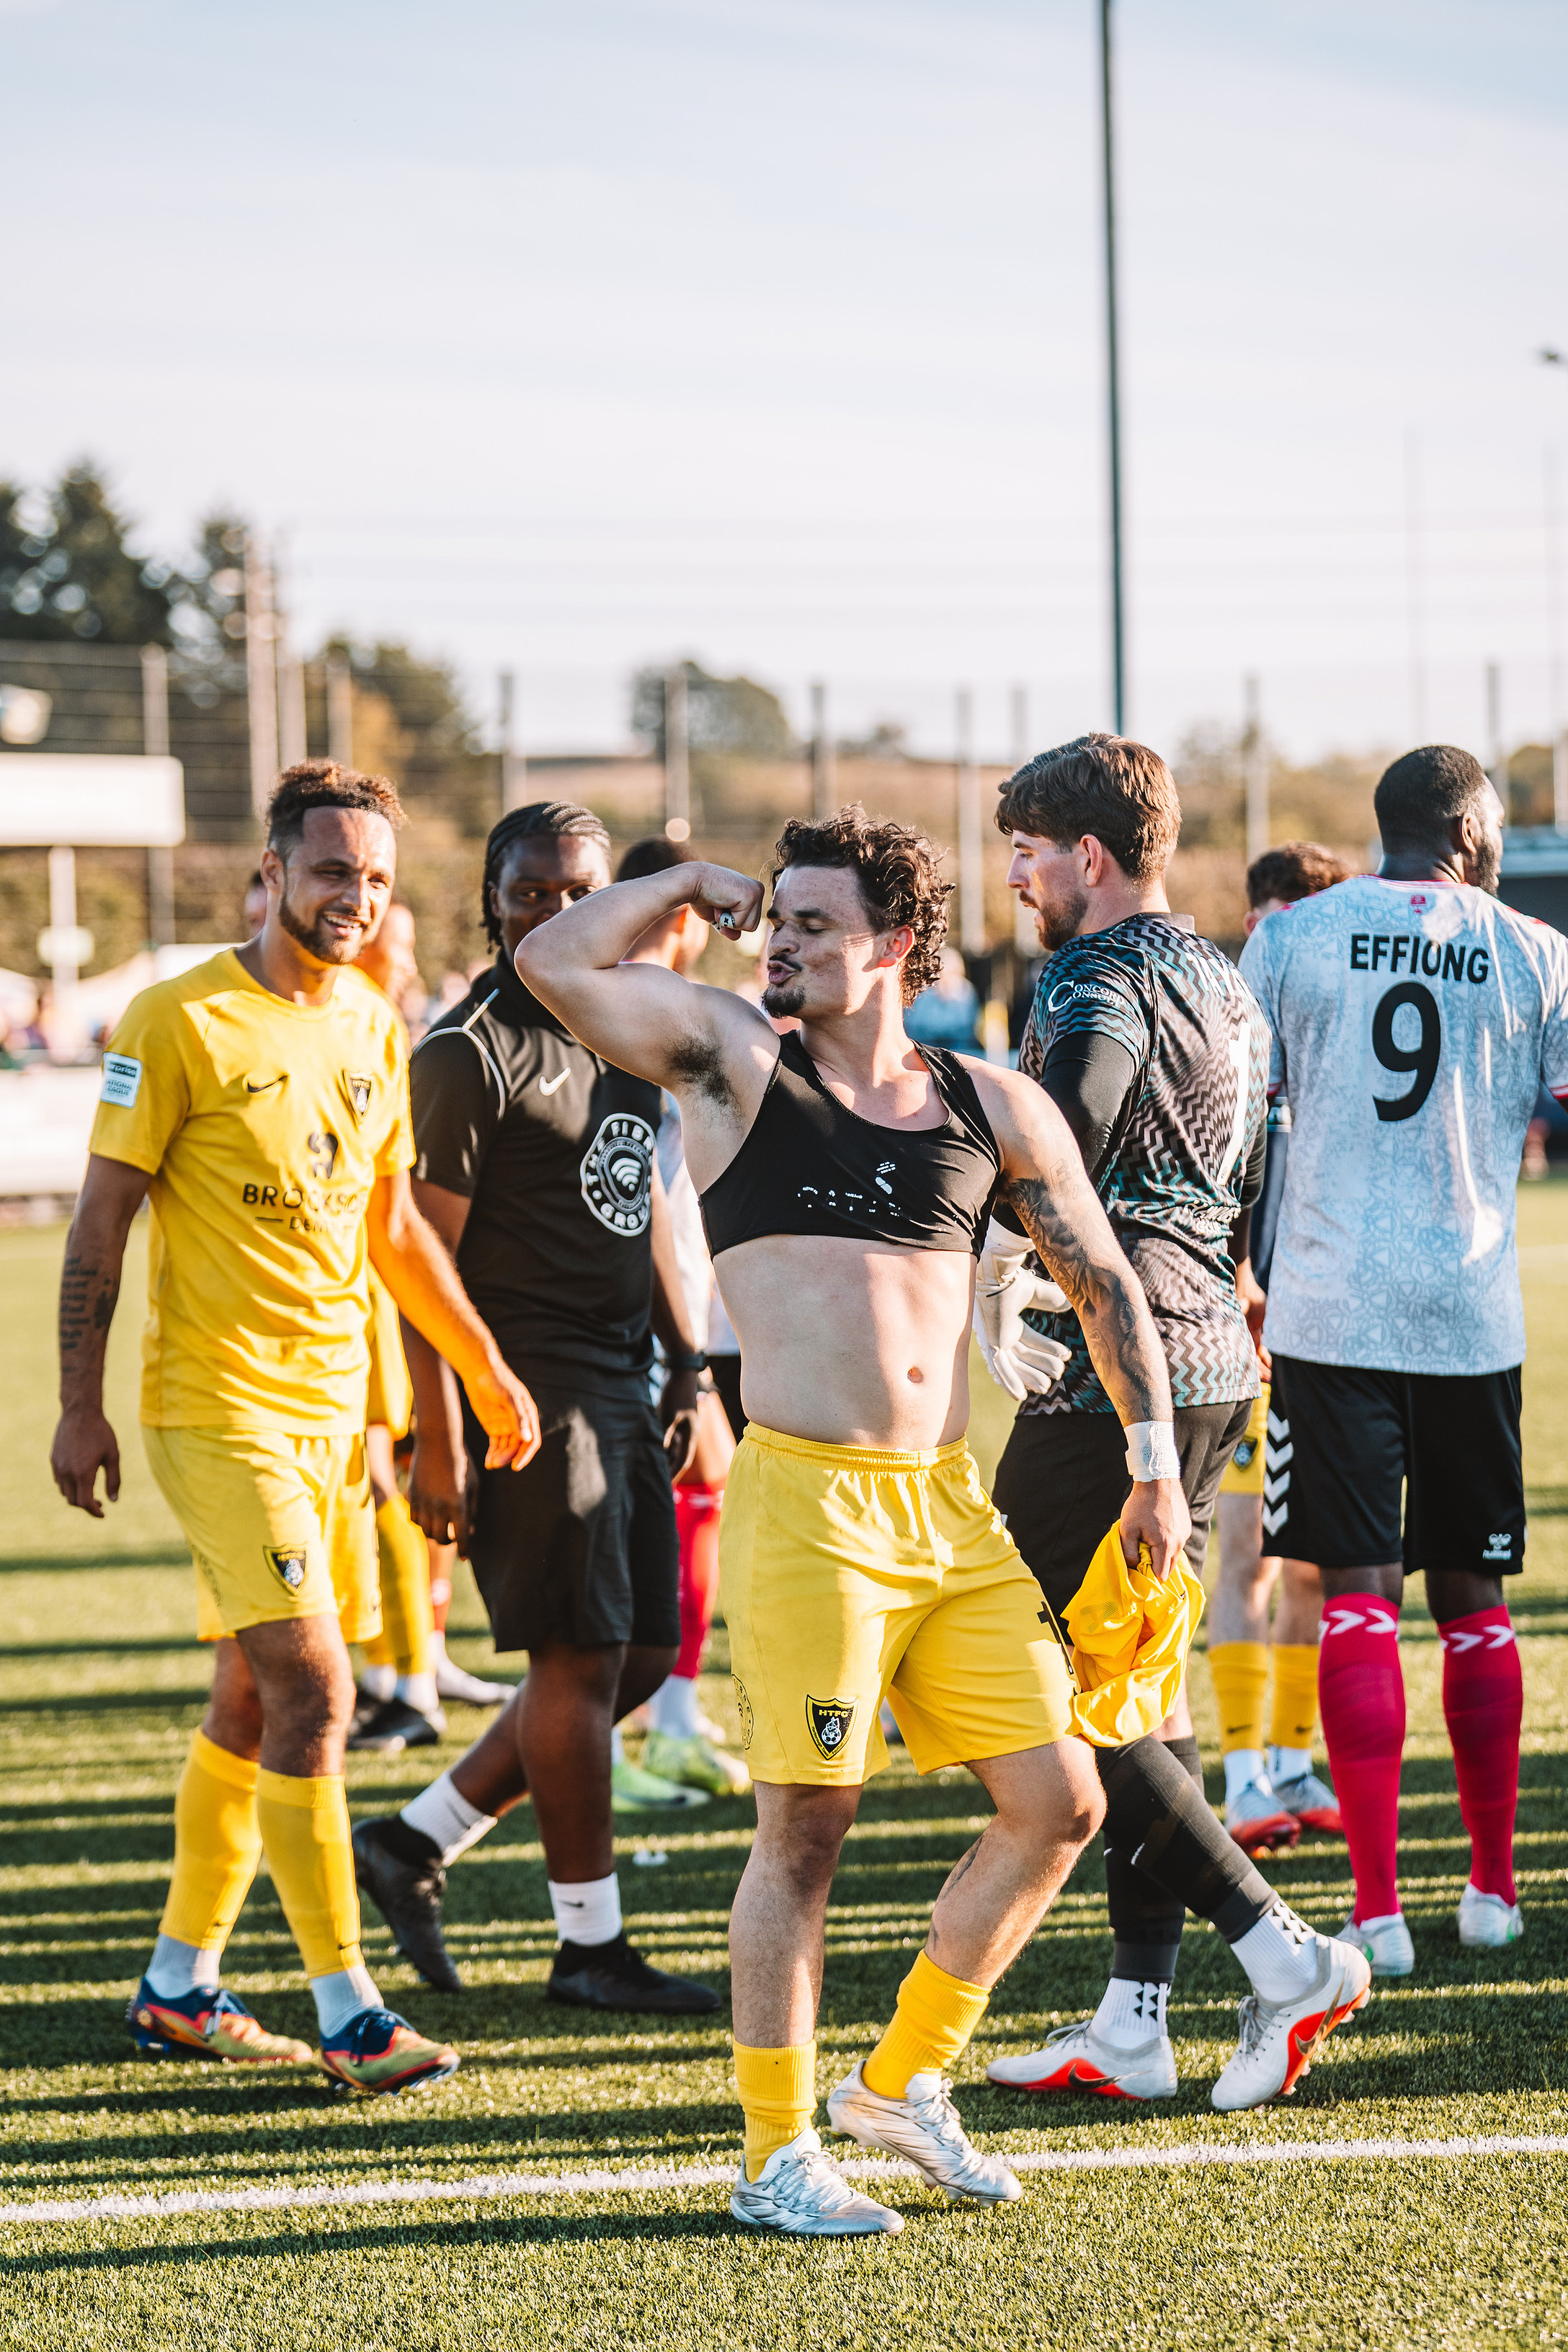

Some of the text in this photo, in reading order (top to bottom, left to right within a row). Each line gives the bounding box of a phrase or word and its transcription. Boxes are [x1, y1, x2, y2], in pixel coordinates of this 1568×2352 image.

[1350, 933, 1489, 984] EFFIONG
[1372, 980, 1441, 1122] 9
[1216, 1022, 1252, 1186] 1
[819, 1709, 849, 1718] HTFC
